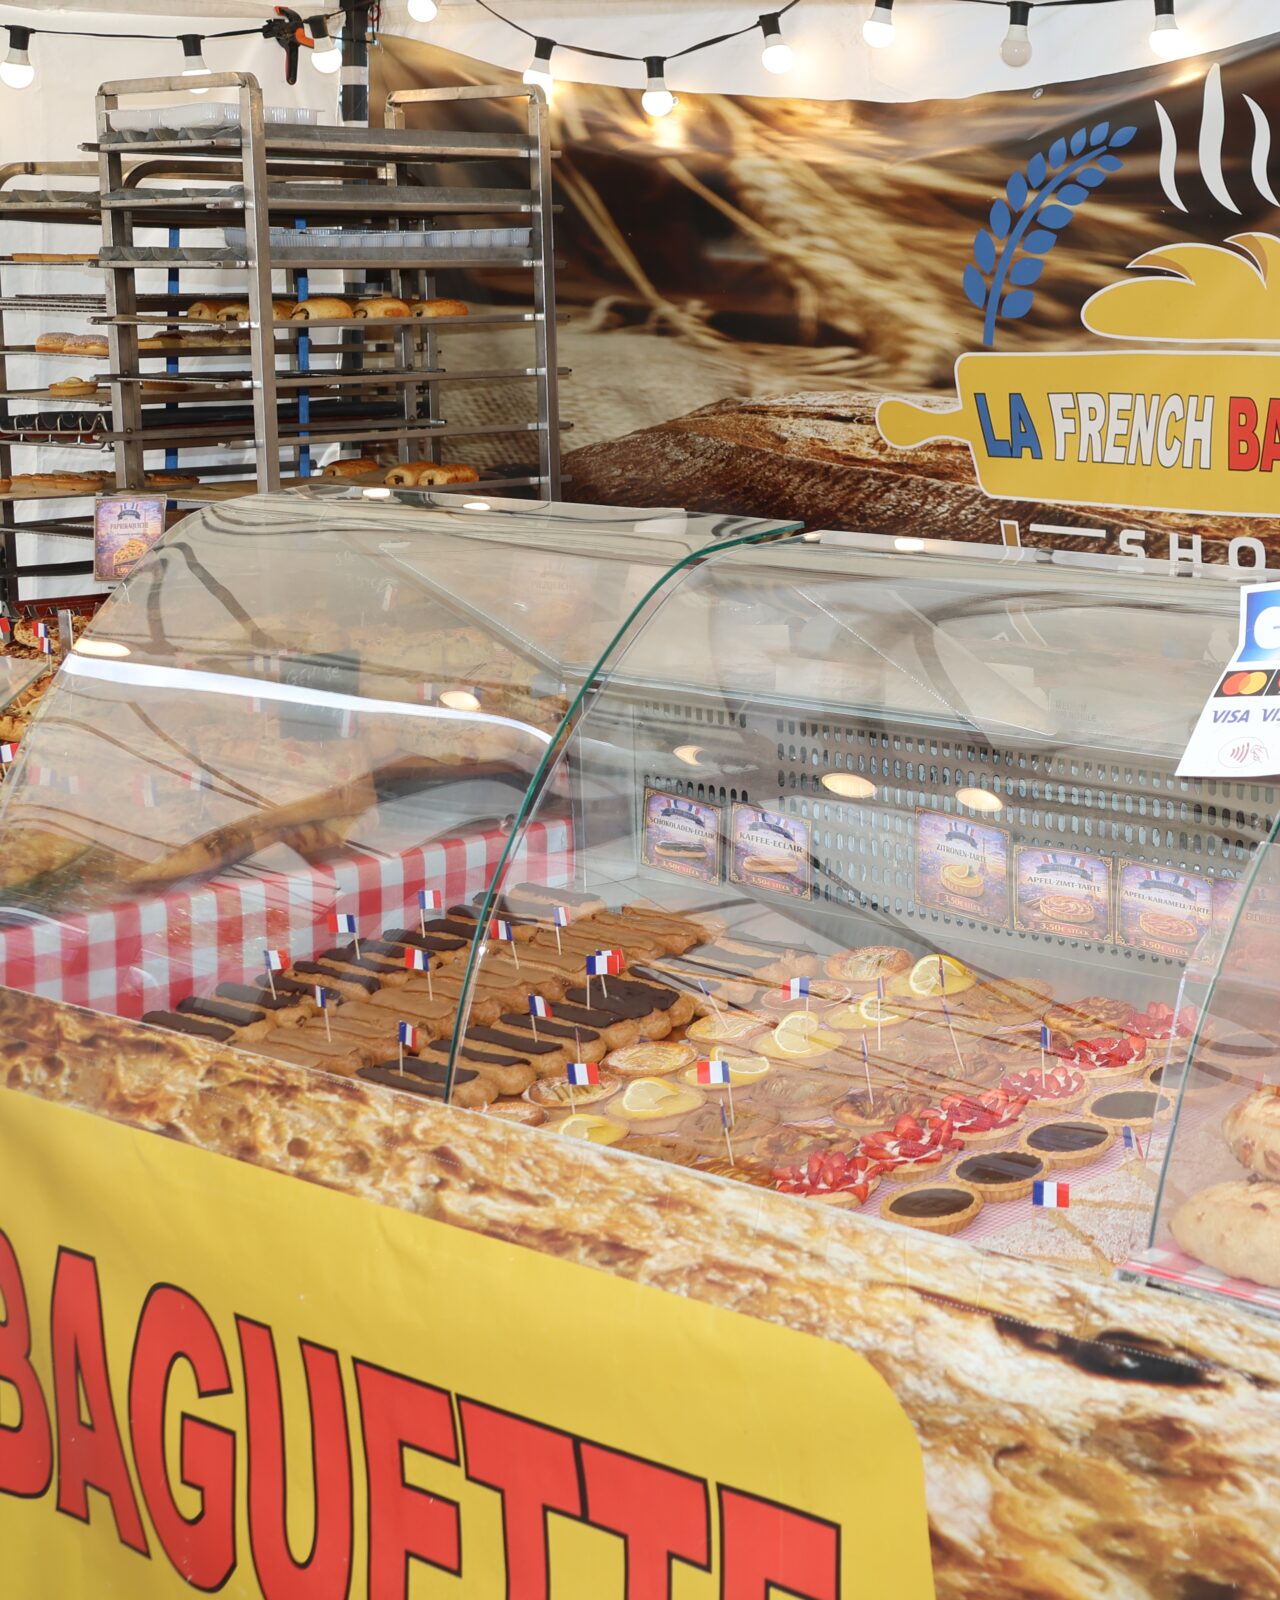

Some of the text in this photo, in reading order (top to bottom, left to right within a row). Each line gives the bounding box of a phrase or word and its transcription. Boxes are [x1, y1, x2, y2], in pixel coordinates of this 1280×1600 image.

[974, 392, 1042, 460] LA
[1047, 391, 1215, 469] FRENCH
[1212, 709, 1251, 724] VISA
[740, 831, 803, 853] KAFFEE-ECLAIR
[1027, 876, 1102, 892] APFEL-ZIMT-TARTE
